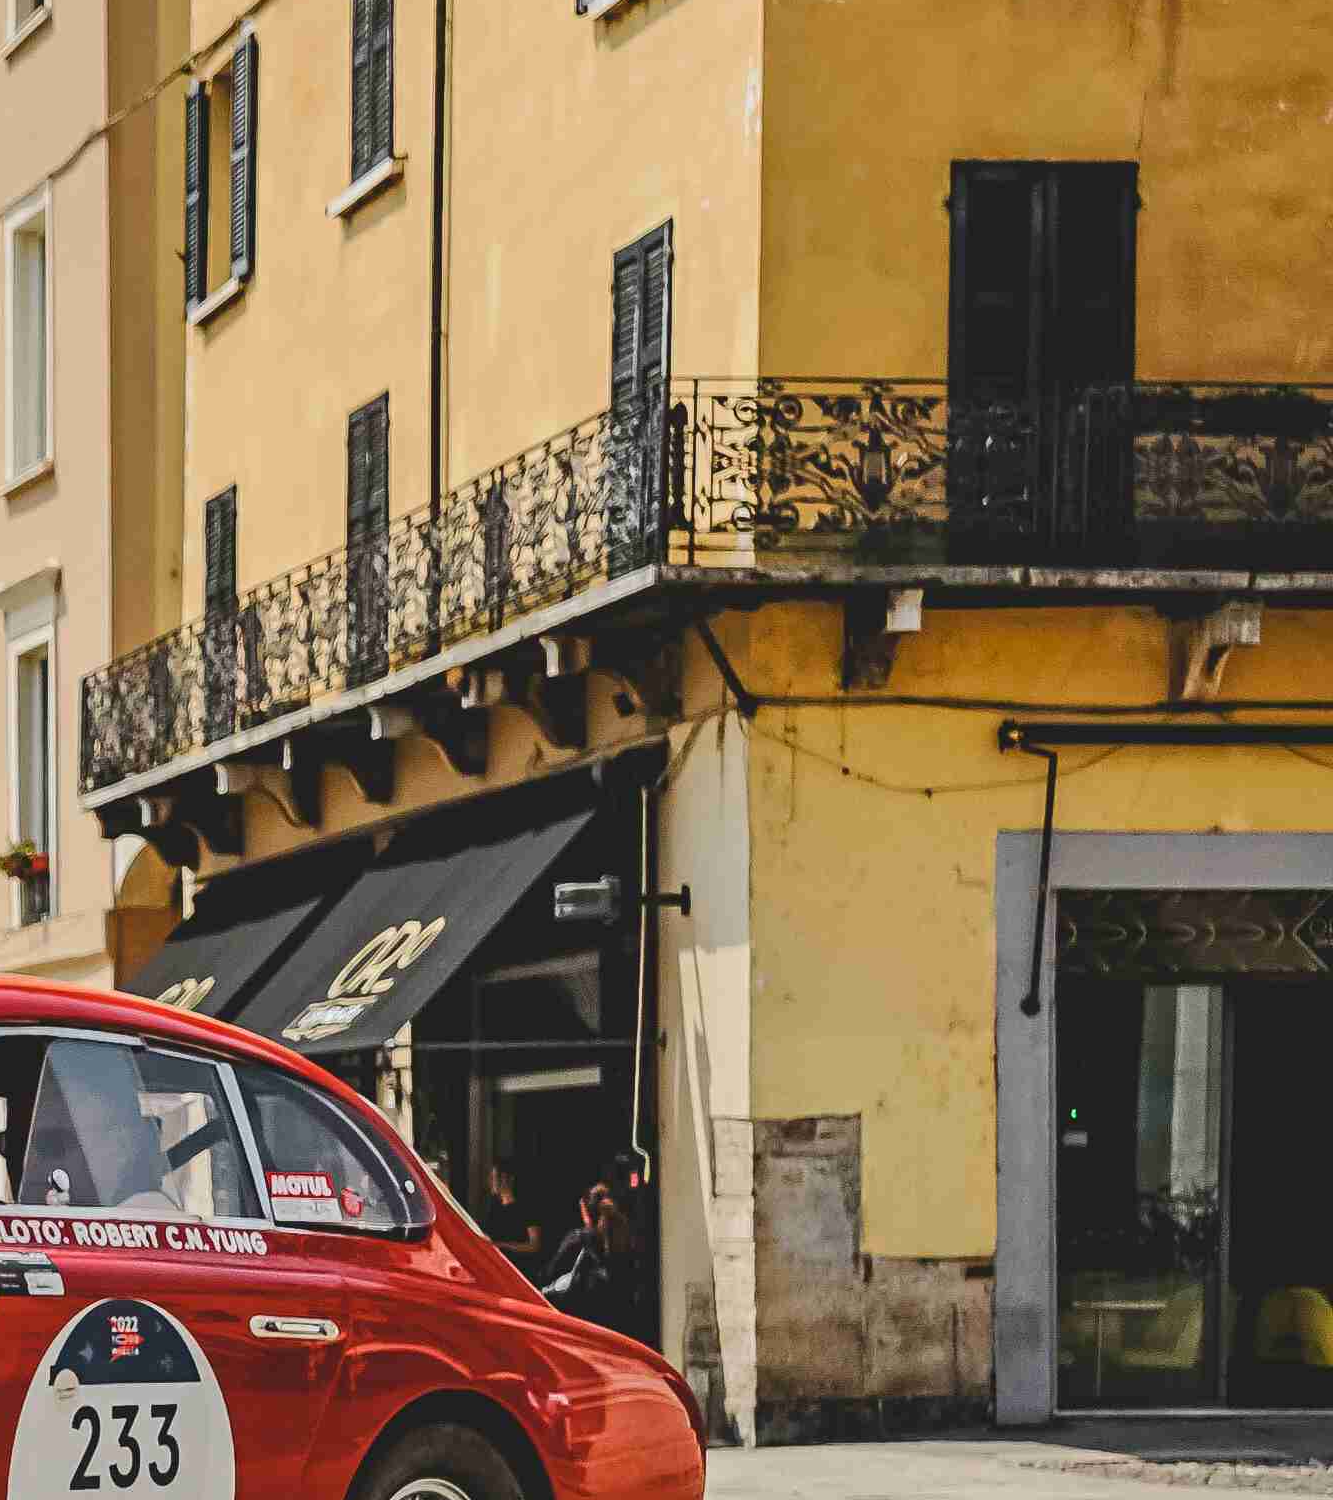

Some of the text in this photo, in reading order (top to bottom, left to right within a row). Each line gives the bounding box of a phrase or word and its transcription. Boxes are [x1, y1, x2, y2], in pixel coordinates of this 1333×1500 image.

[271, 1175, 332, 1197] MOTUL
[70, 1221, 160, 1249] ROBERT
[69, 1404, 180, 1491] 233
